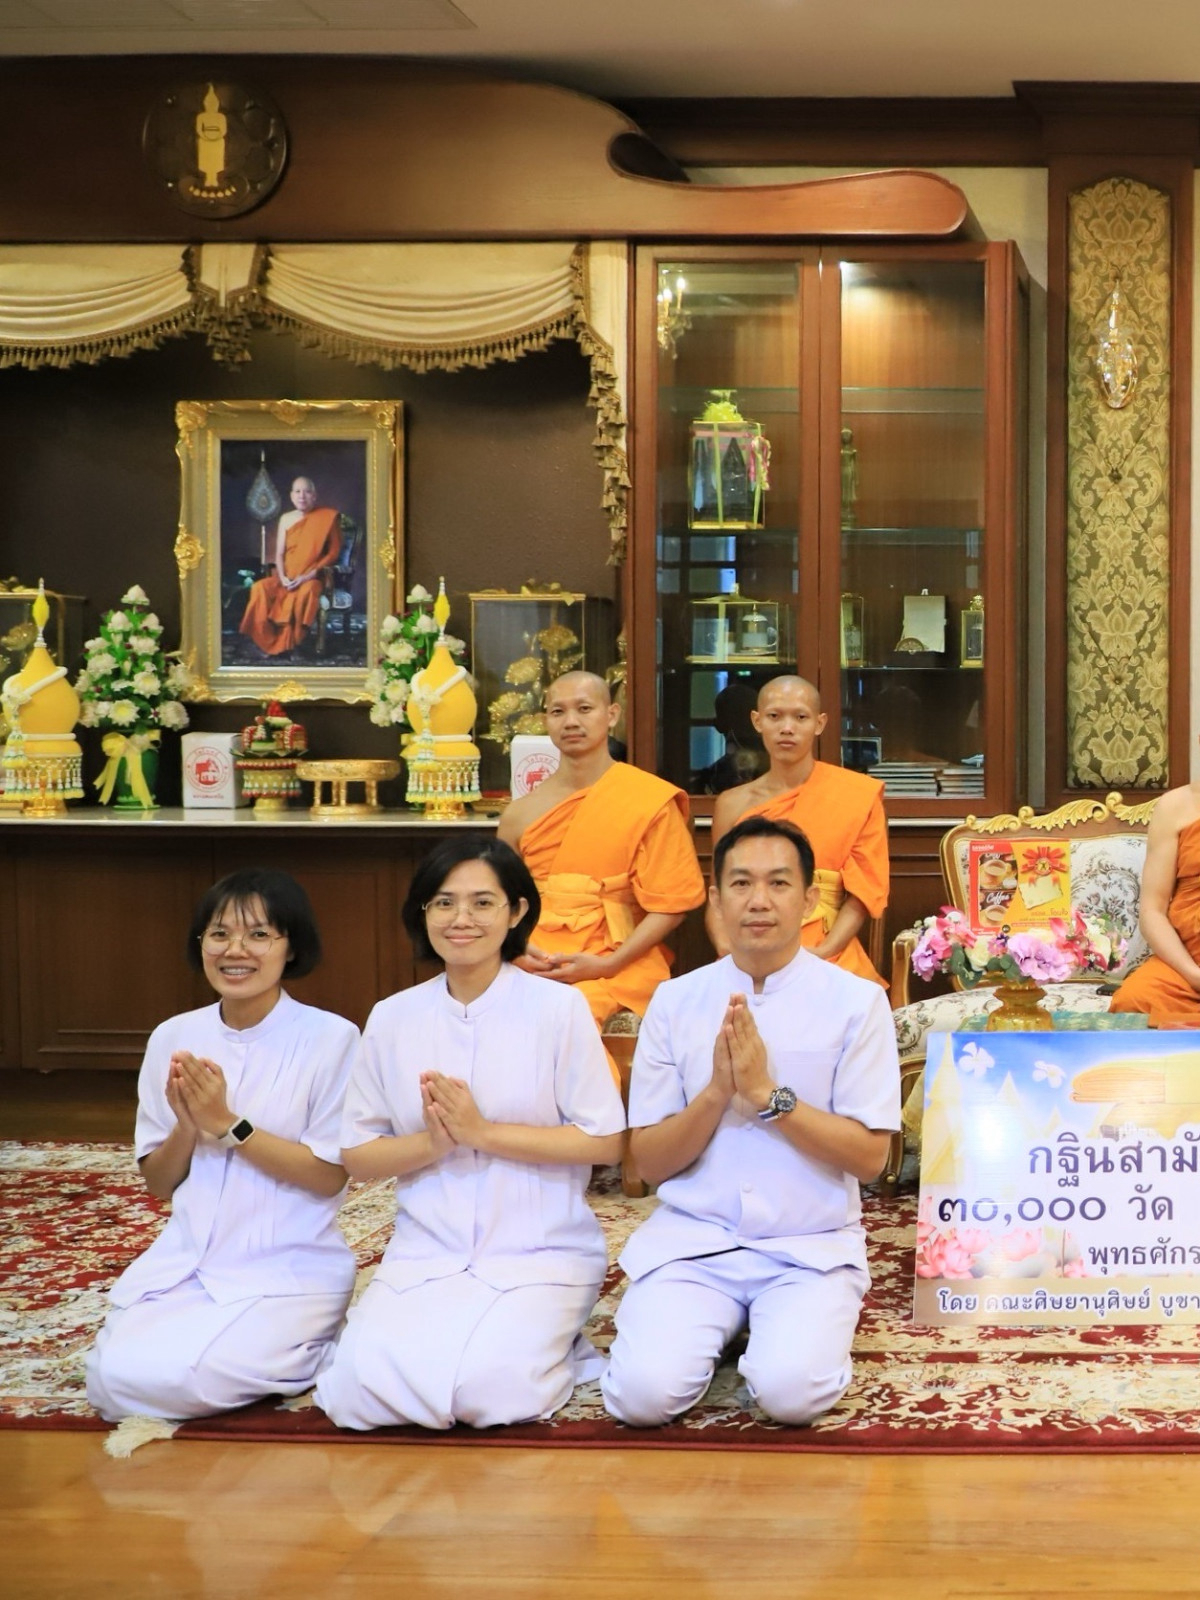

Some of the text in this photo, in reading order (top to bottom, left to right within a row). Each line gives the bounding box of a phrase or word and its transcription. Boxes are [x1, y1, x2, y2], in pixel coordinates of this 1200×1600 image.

[938, 1196, 1107, 1227] ๓๐,๐๐๐
[1128, 1184, 1174, 1221] วัด
[939, 1289, 977, 1311] โดย
[986, 1288, 1151, 1316] คณะศิษยานุศิษย์
